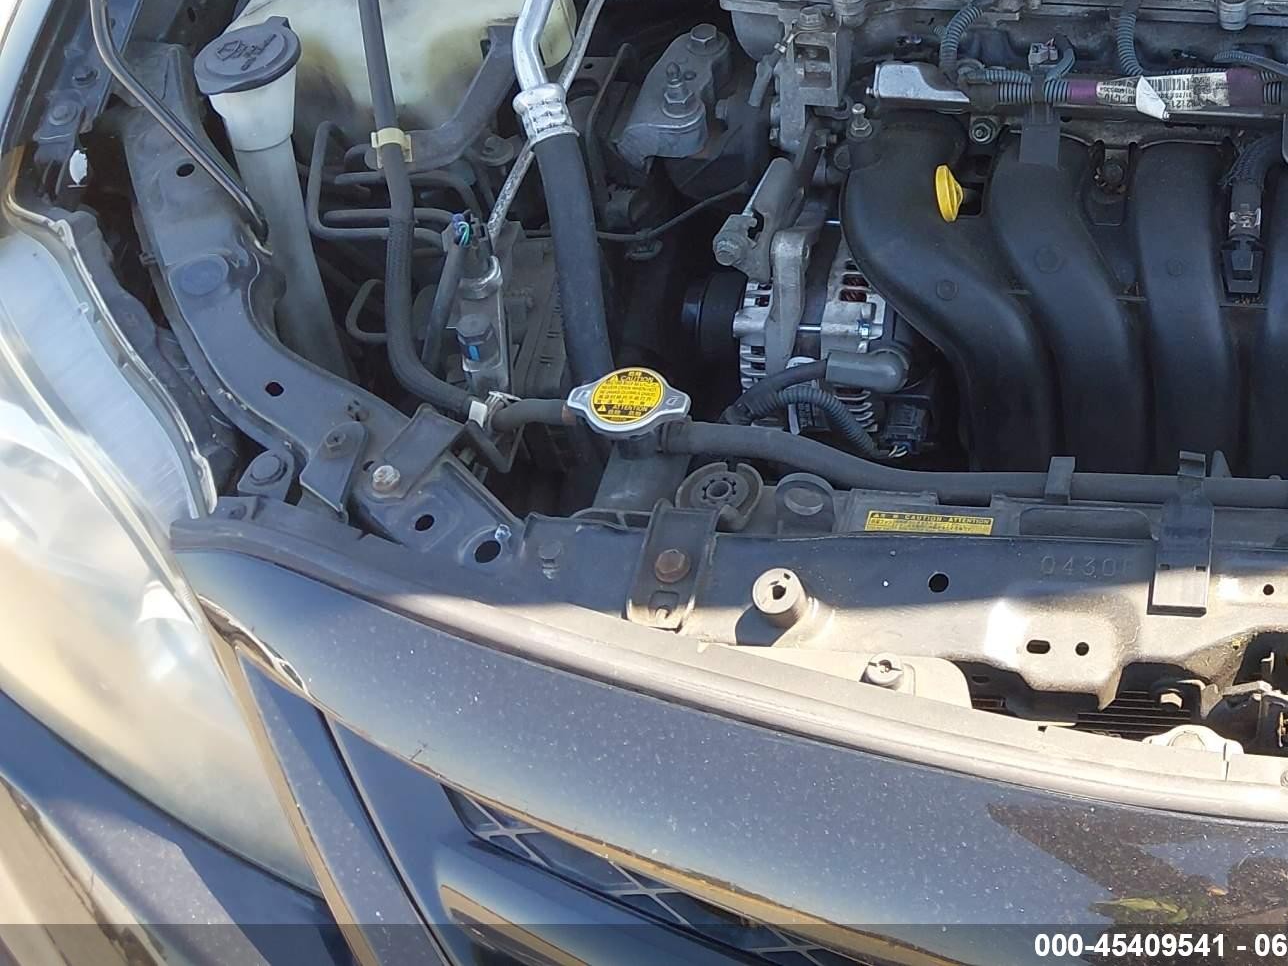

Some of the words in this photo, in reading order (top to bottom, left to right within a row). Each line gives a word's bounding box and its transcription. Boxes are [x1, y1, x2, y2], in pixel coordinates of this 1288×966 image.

[620, 375, 653, 383] CAUTION
[612, 404, 648, 412] ATTENTION
[904, 514, 943, 522] CAUTION
